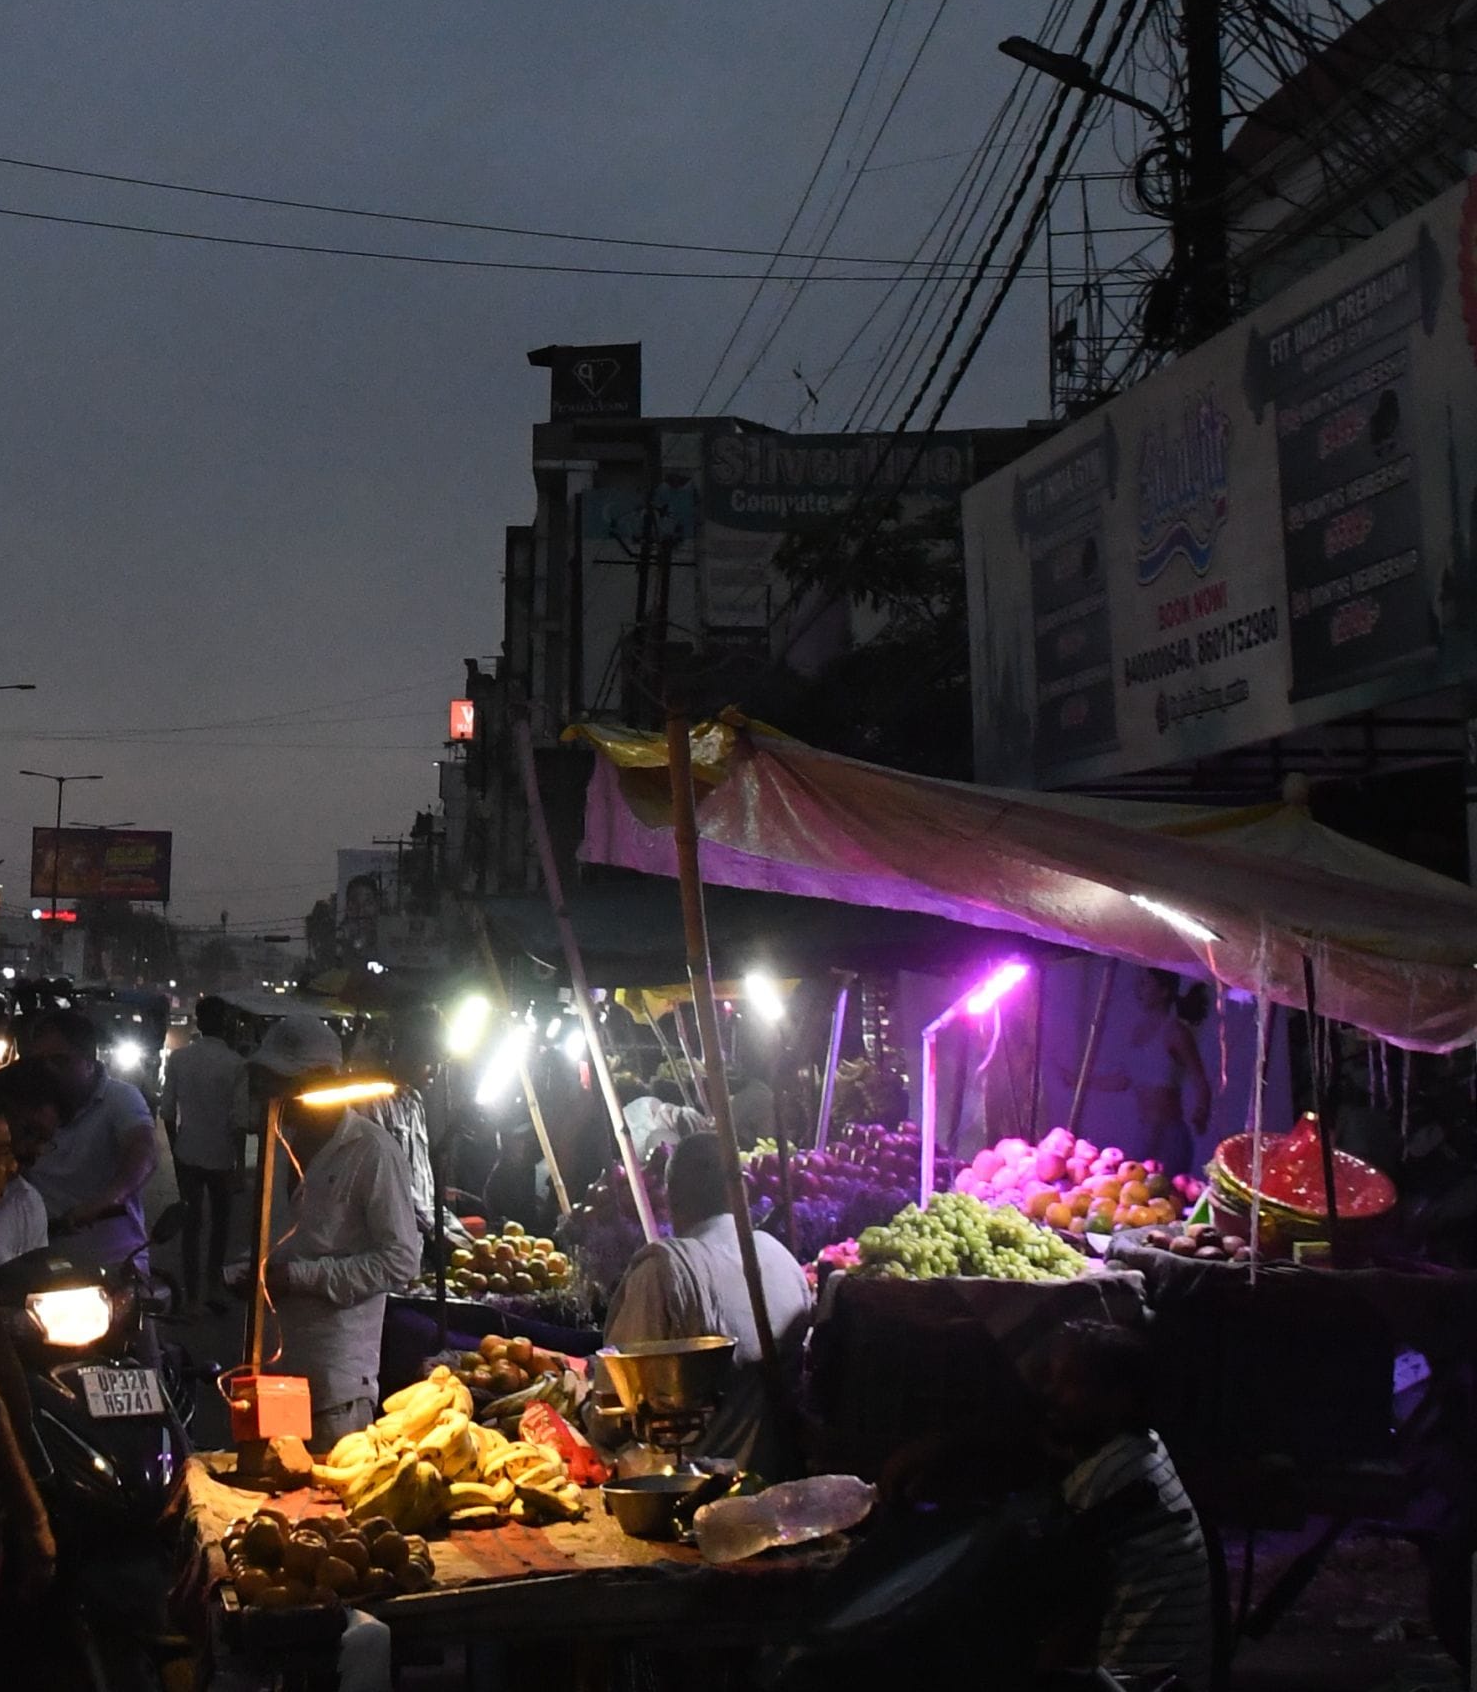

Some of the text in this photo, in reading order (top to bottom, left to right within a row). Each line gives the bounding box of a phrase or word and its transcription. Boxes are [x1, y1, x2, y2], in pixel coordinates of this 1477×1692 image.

[1269, 264, 1409, 367] FIT INDIA PREMIUM
[730, 489, 837, 515] Compute
[97, 1370, 150, 1392] UP32R
[104, 1392, 153, 1414] H5741
